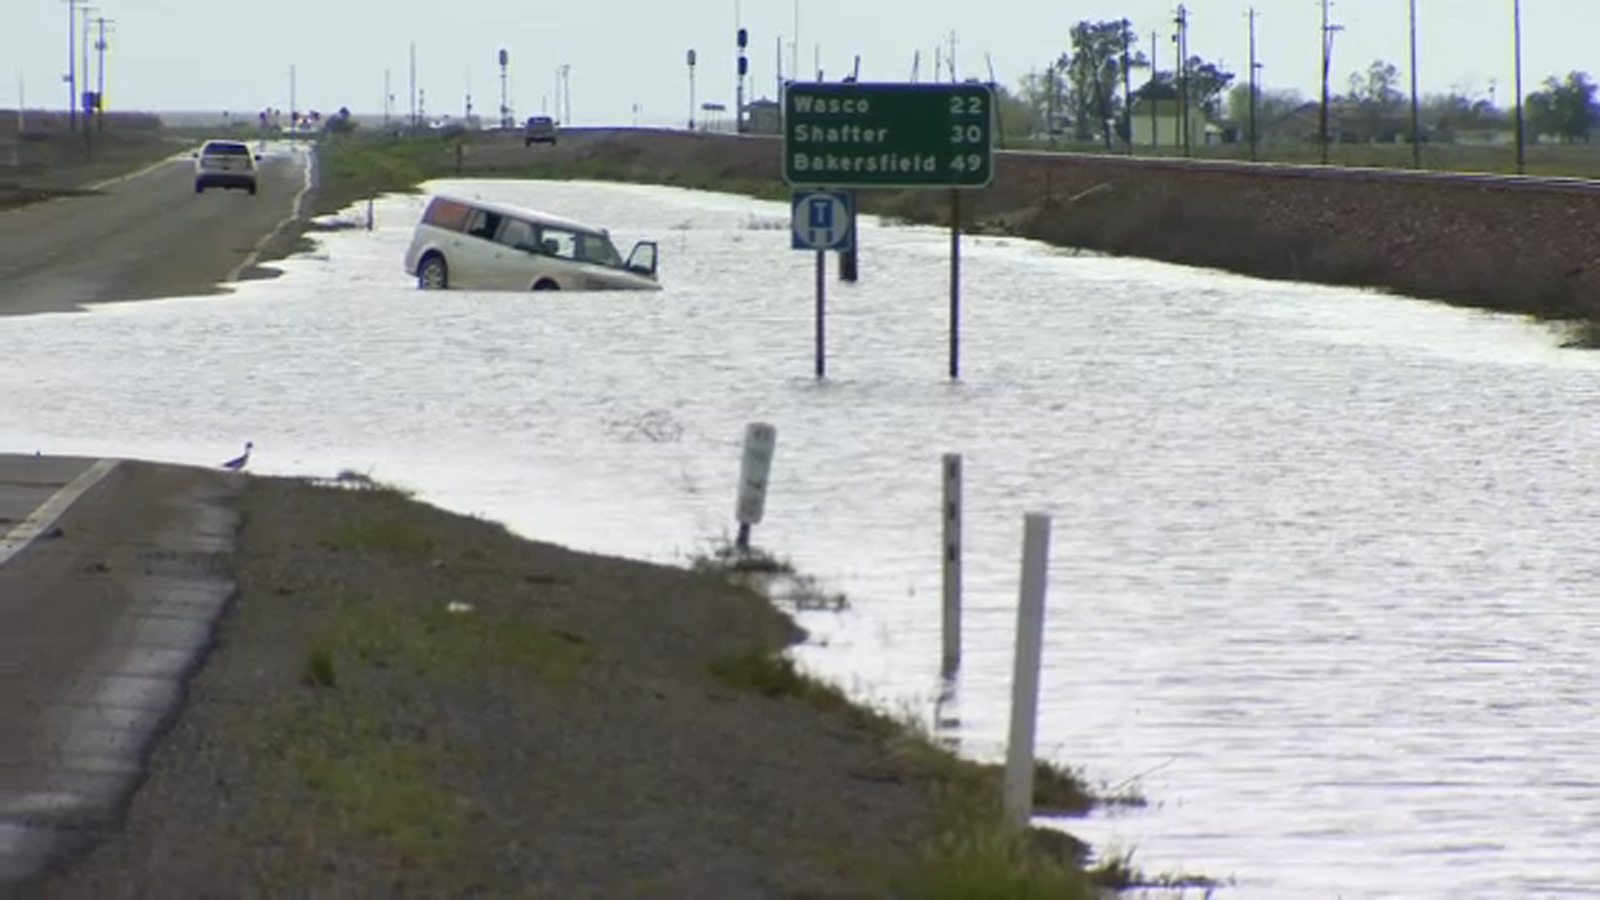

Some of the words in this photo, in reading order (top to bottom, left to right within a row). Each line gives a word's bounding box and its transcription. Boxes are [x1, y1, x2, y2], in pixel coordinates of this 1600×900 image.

[794, 96, 869, 113] Wasco
[949, 96, 983, 114] 22
[794, 124, 888, 142] Shafter
[950, 125, 982, 143] 30
[794, 153, 936, 171] Bakersfield
[950, 154, 982, 172] 49
[812, 202, 828, 223] T
